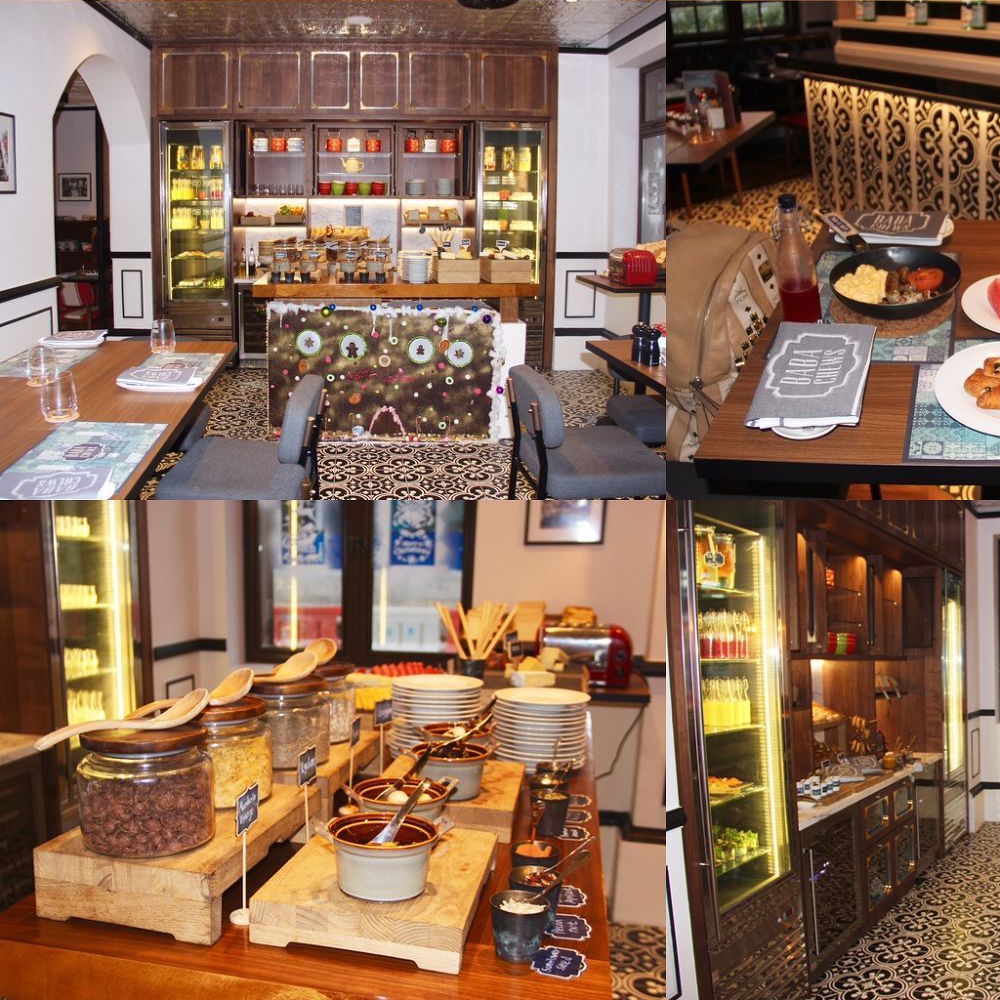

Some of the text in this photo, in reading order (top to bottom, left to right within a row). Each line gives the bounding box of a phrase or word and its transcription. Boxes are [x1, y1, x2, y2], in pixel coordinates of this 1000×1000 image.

[873, 213, 913, 225] BABA
[780, 350, 823, 385] BABA
[813, 348, 847, 385] CHEWS
